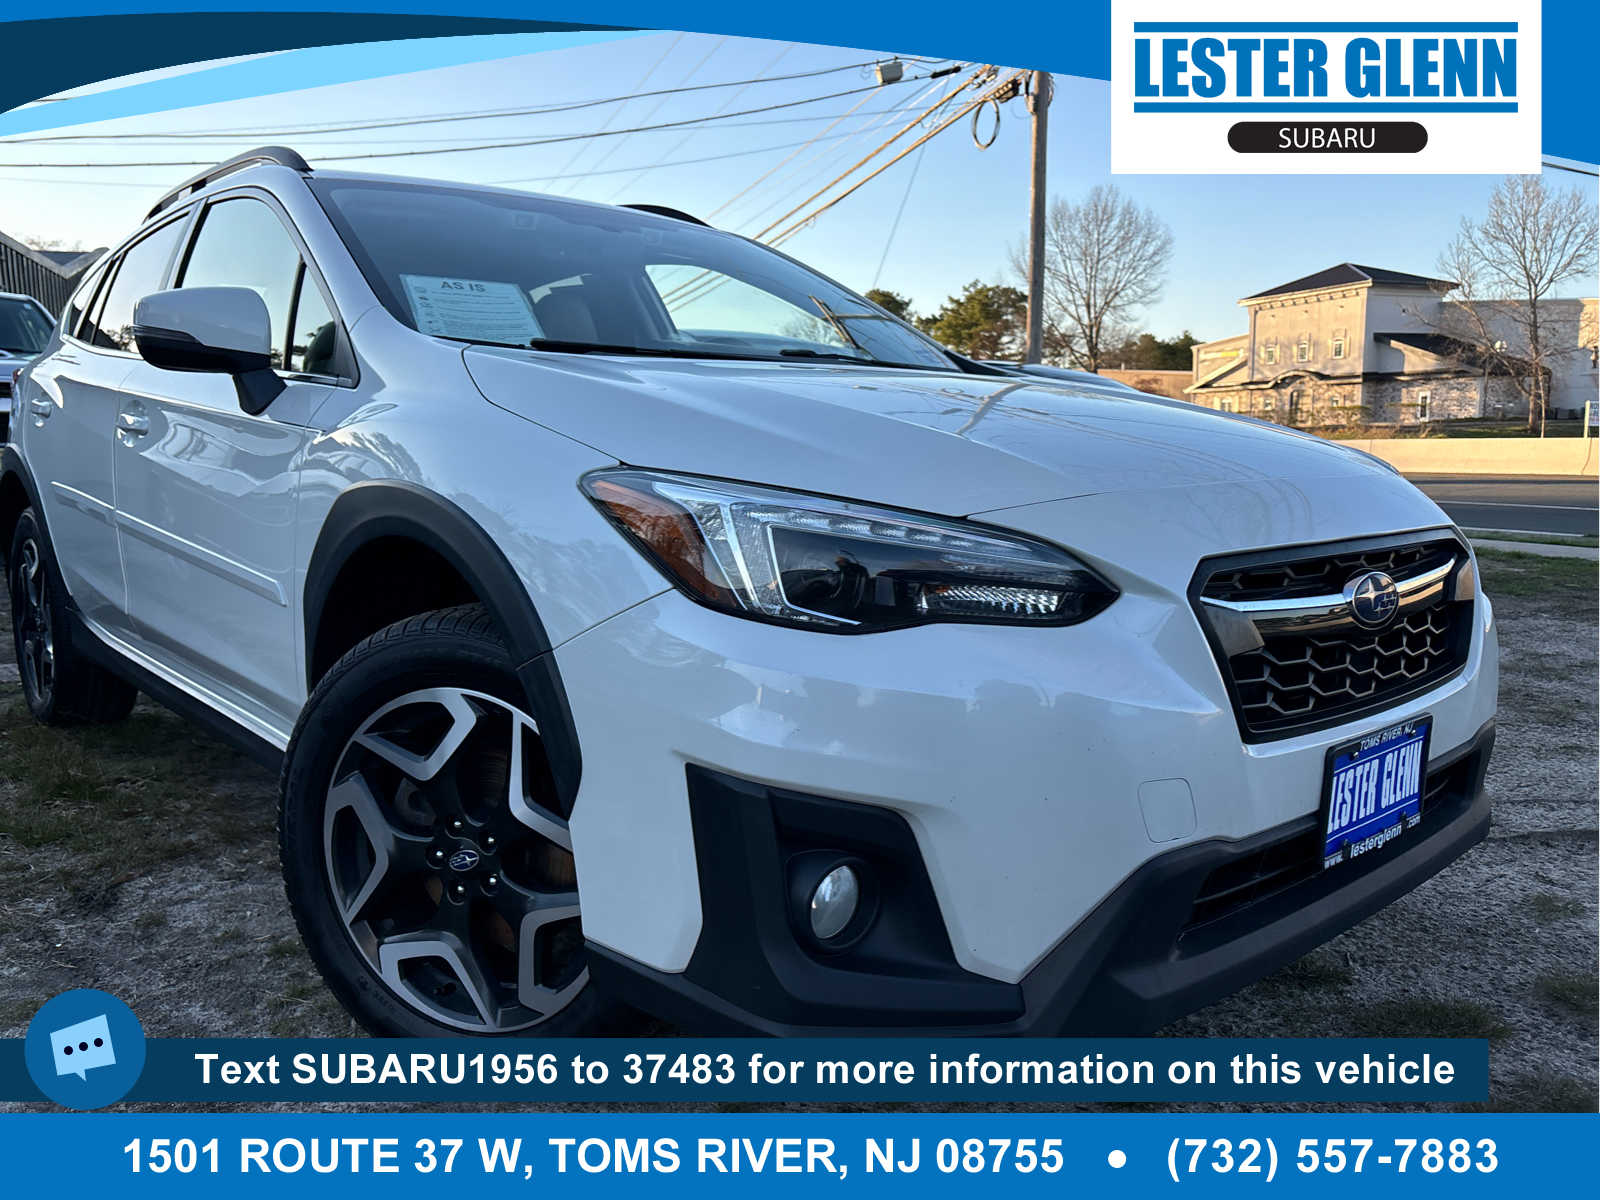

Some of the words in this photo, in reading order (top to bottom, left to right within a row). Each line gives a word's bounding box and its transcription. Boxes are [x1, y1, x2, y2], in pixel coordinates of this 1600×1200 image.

[441, 281, 464, 290] AS
[468, 283, 486, 292] IS
[1360, 734, 1380, 751] TOMS
[1327, 758, 1380, 835] LESTER
[1381, 740, 1424, 809] GLENN
[1350, 824, 1402, 859] lesterglenn
